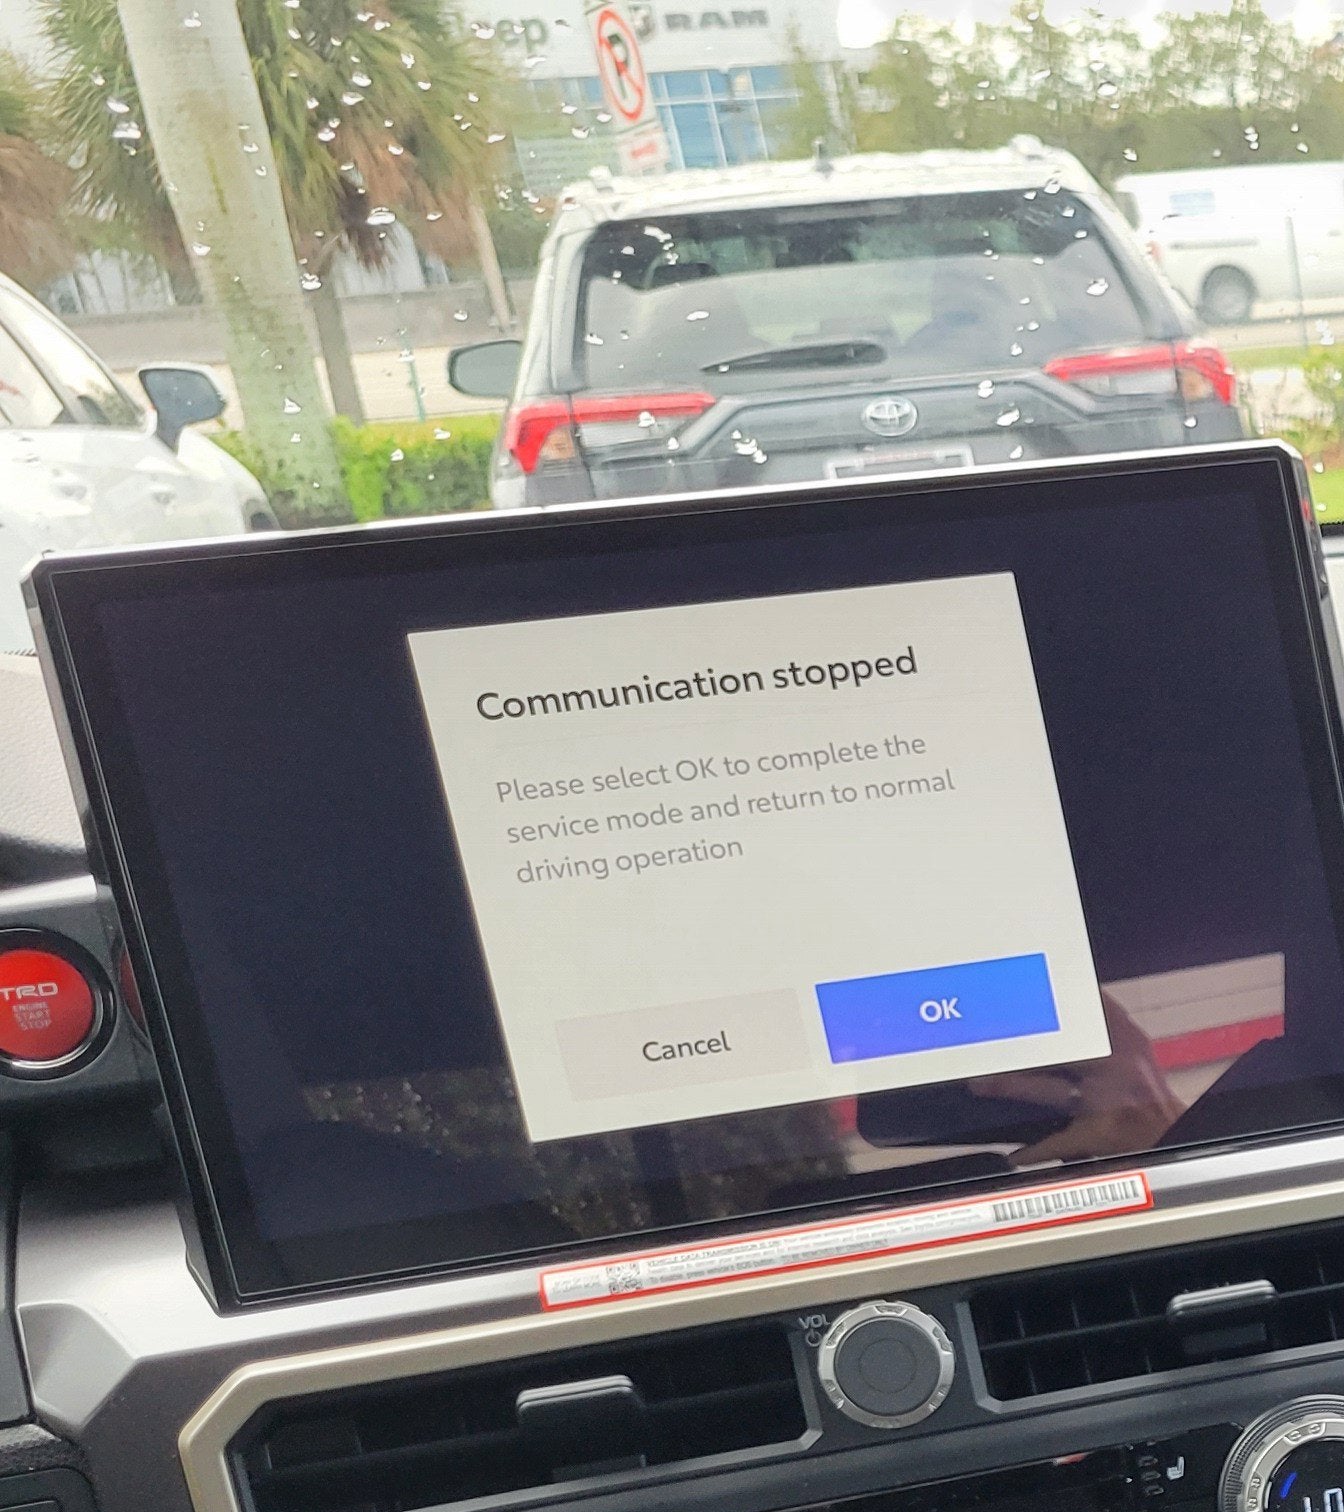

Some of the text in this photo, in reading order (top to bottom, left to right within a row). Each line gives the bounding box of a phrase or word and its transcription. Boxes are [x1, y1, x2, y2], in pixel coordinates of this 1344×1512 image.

[664, 10, 769, 31] RAM
[475, 646, 919, 721] Communication stopped
[496, 734, 927, 804] Please select OK to complete the
[506, 768, 955, 844] service mode and return to normal
[516, 835, 744, 886] driving operation
[0, 982, 59, 1000] TRD
[919, 996, 962, 1025] OK
[641, 1030, 732, 1063] Cancel
[799, 1314, 830, 1329] VOL
